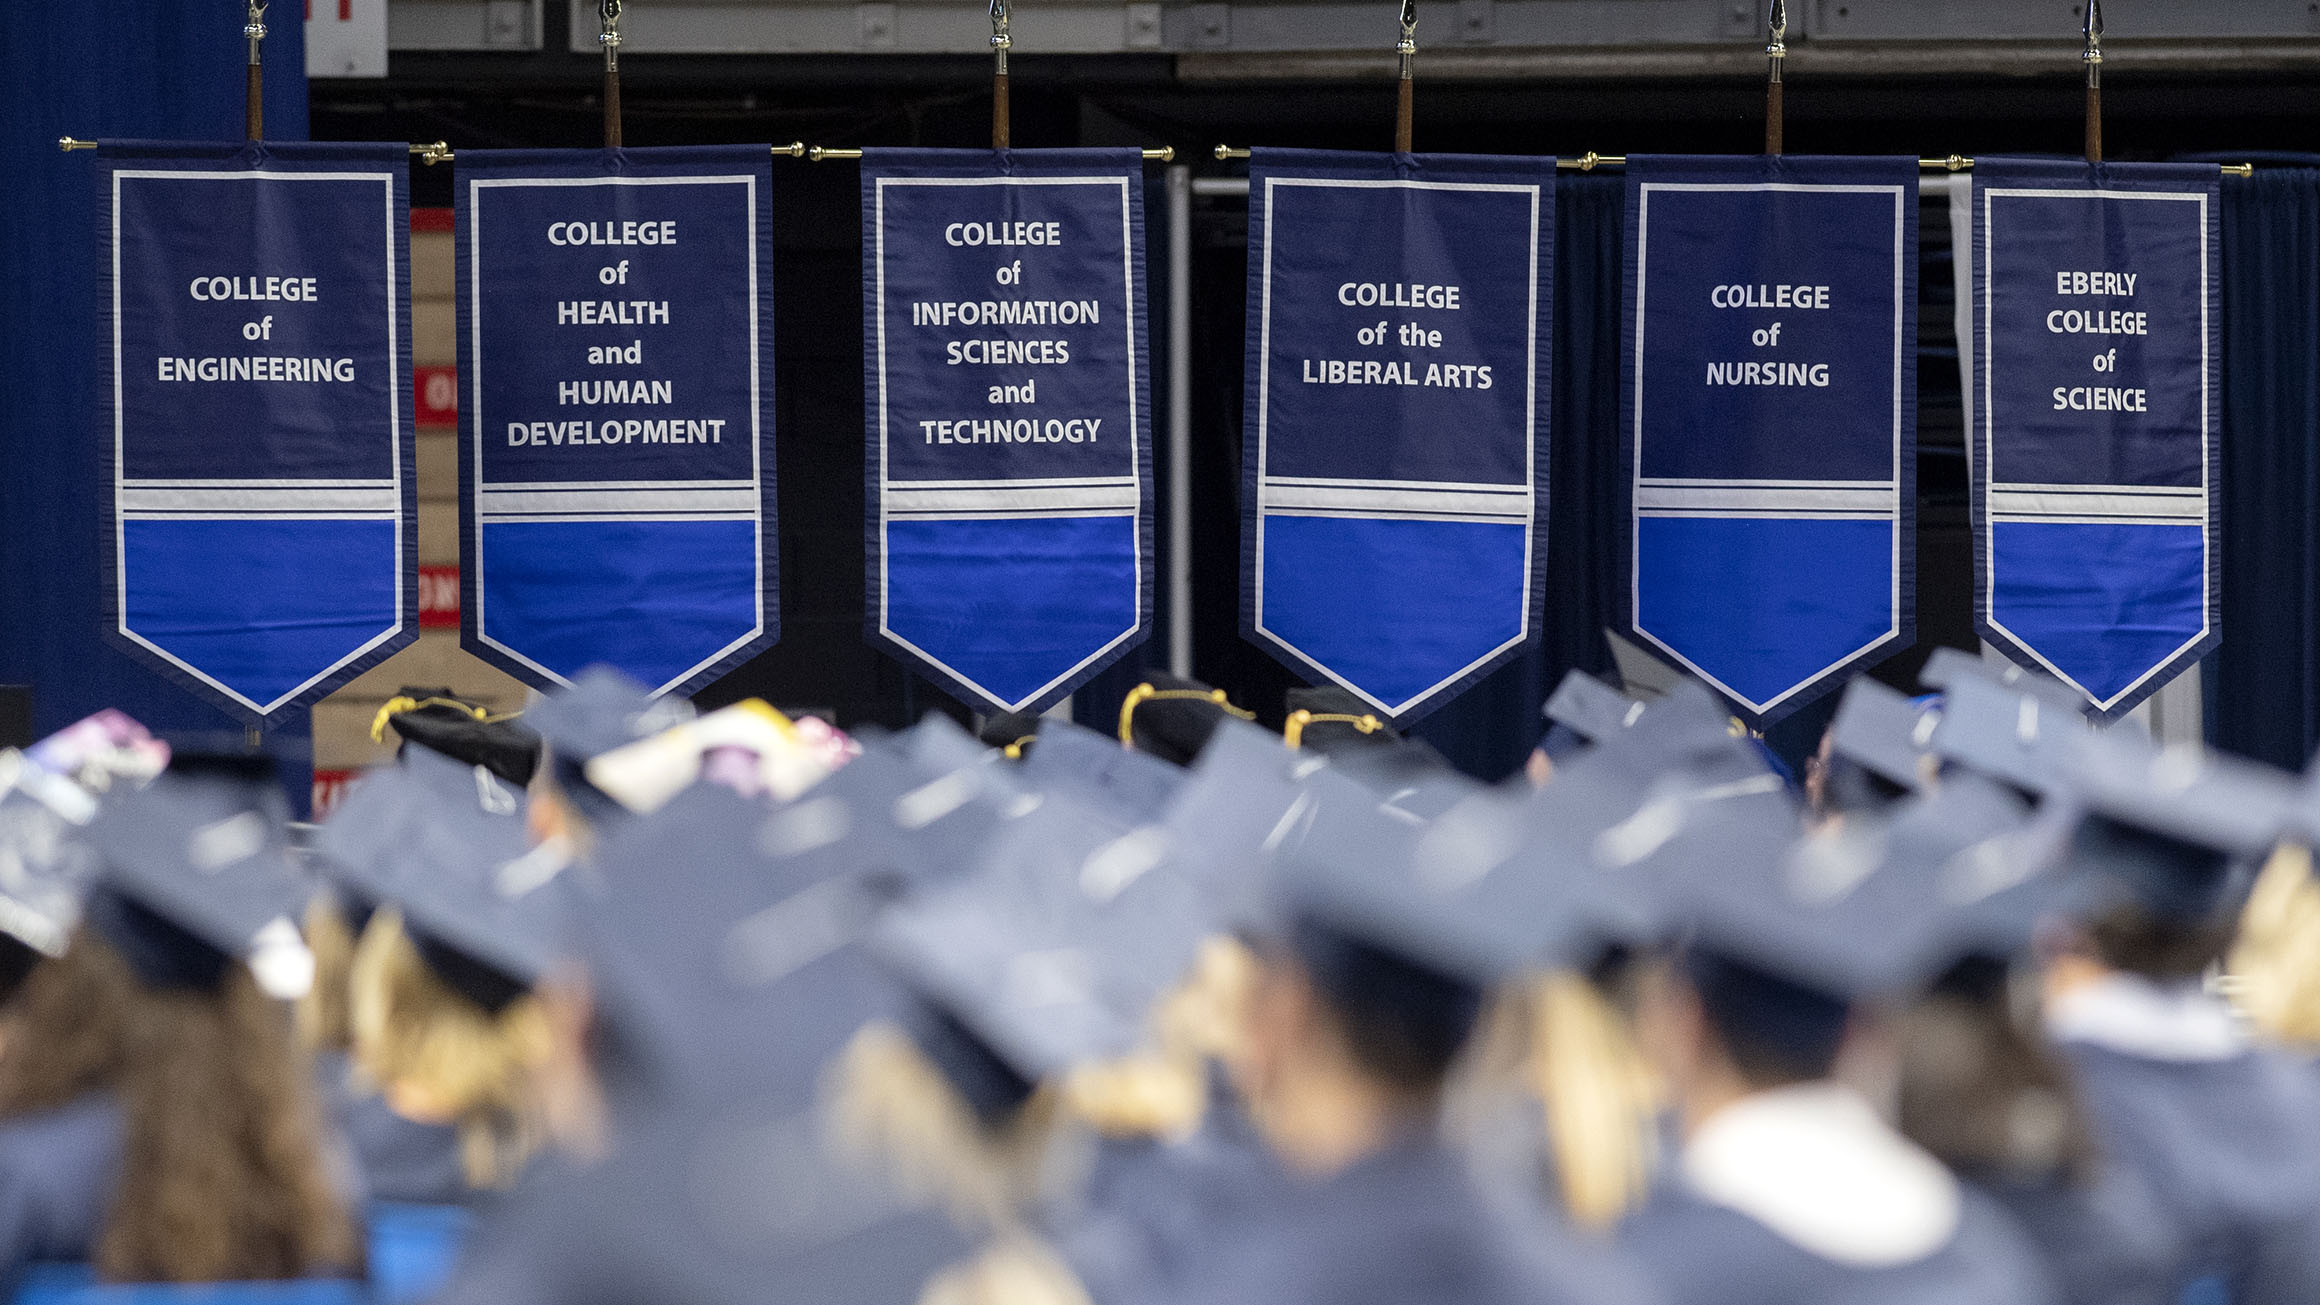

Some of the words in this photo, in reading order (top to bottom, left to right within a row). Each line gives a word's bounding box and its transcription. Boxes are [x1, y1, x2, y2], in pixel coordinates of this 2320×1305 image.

[547, 220, 677, 246] COLLEGE
[945, 221, 1061, 247] COLLEGE
[599, 259, 629, 285] of
[996, 259, 1022, 285] of
[2057, 271, 2137, 297] EBERLY
[190, 276, 318, 302] COLLEGE
[1338, 282, 1460, 310] COLLEGE
[1711, 284, 1830, 309] COLLEGE
[558, 300, 670, 325] HEALTH
[912, 300, 1100, 326] INFORMATION
[2046, 309, 2148, 336] COLLEGE
[242, 315, 273, 341] of
[1357, 320, 1388, 346] of
[1398, 321, 1443, 348] the
[1751, 322, 1782, 347] of
[587, 339, 642, 365] and
[946, 339, 1070, 365] SCIENCES
[2092, 347, 2116, 373] of
[158, 356, 355, 383] ENGINEERING
[1303, 359, 1418, 386] LIBERAL
[1424, 362, 1493, 390] ARTS
[1706, 361, 1830, 387] NURSING
[559, 380, 672, 405] HUMAN
[988, 378, 1036, 404] and
[2052, 386, 2147, 412] SCIENCE
[508, 419, 726, 447] DEVELOPMENT
[919, 418, 1102, 445] TECHNOLOGY
